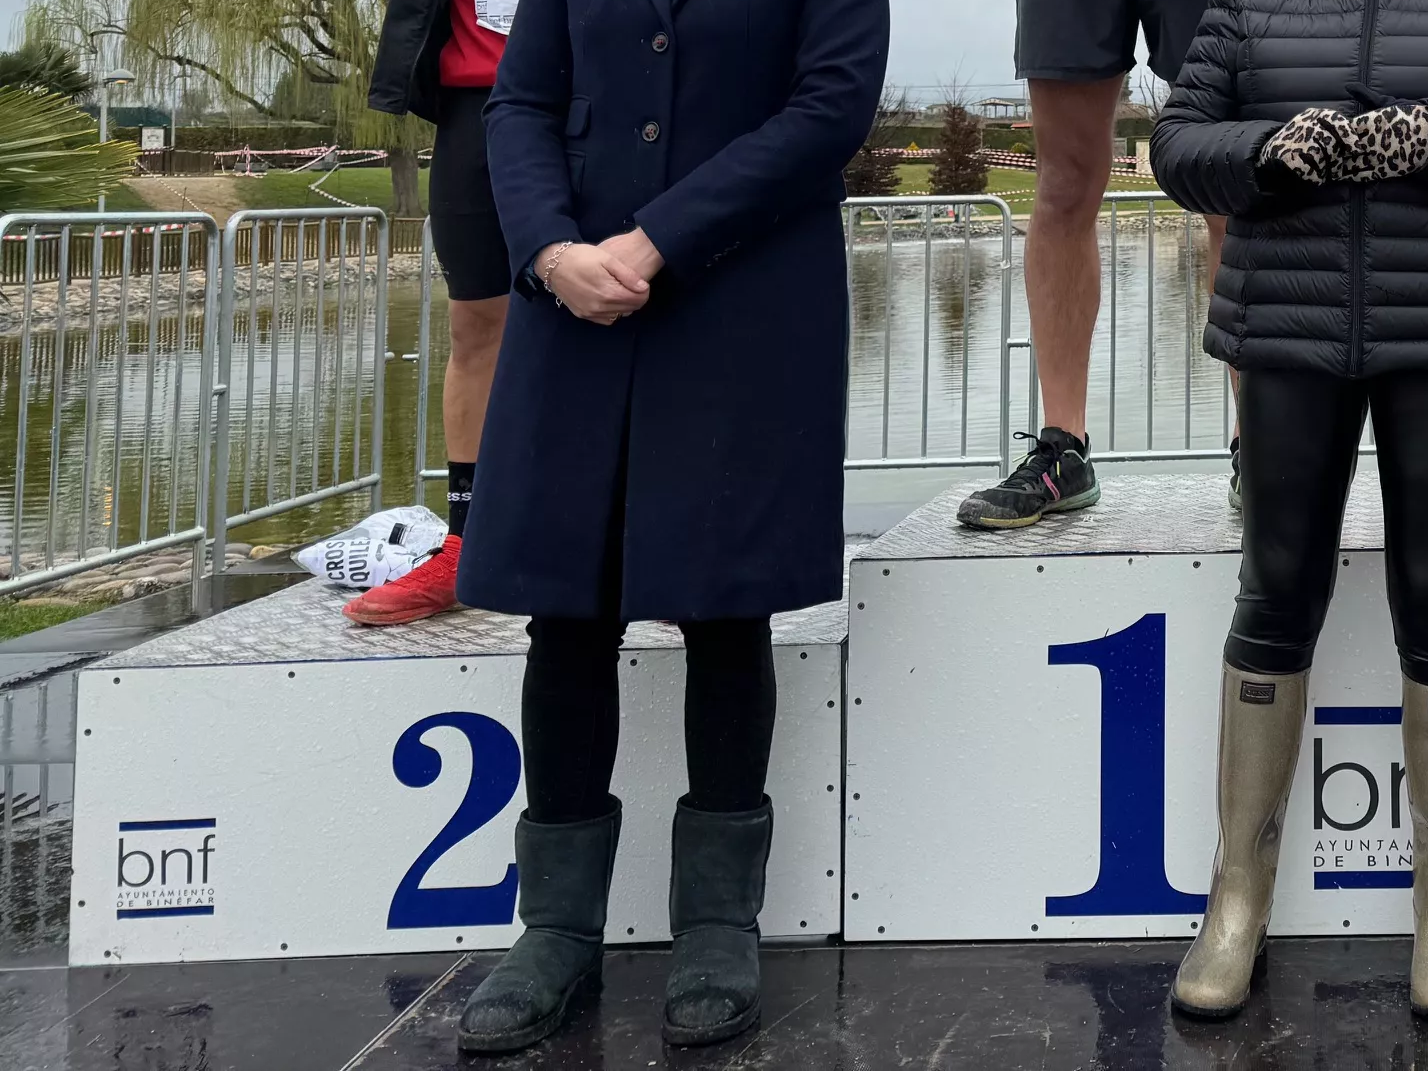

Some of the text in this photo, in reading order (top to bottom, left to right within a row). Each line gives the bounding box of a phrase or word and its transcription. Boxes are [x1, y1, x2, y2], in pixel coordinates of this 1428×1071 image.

[325, 540, 346, 581] CROS
[349, 538, 371, 583] QUILE
[1045, 613, 1208, 917] 1
[387, 712, 521, 930] 2
[118, 834, 215, 888] bnf
[1313, 855, 1344, 868] DE
[117, 888, 214, 899] AYUNTAMIENTO
[117, 900, 134, 908] DE
